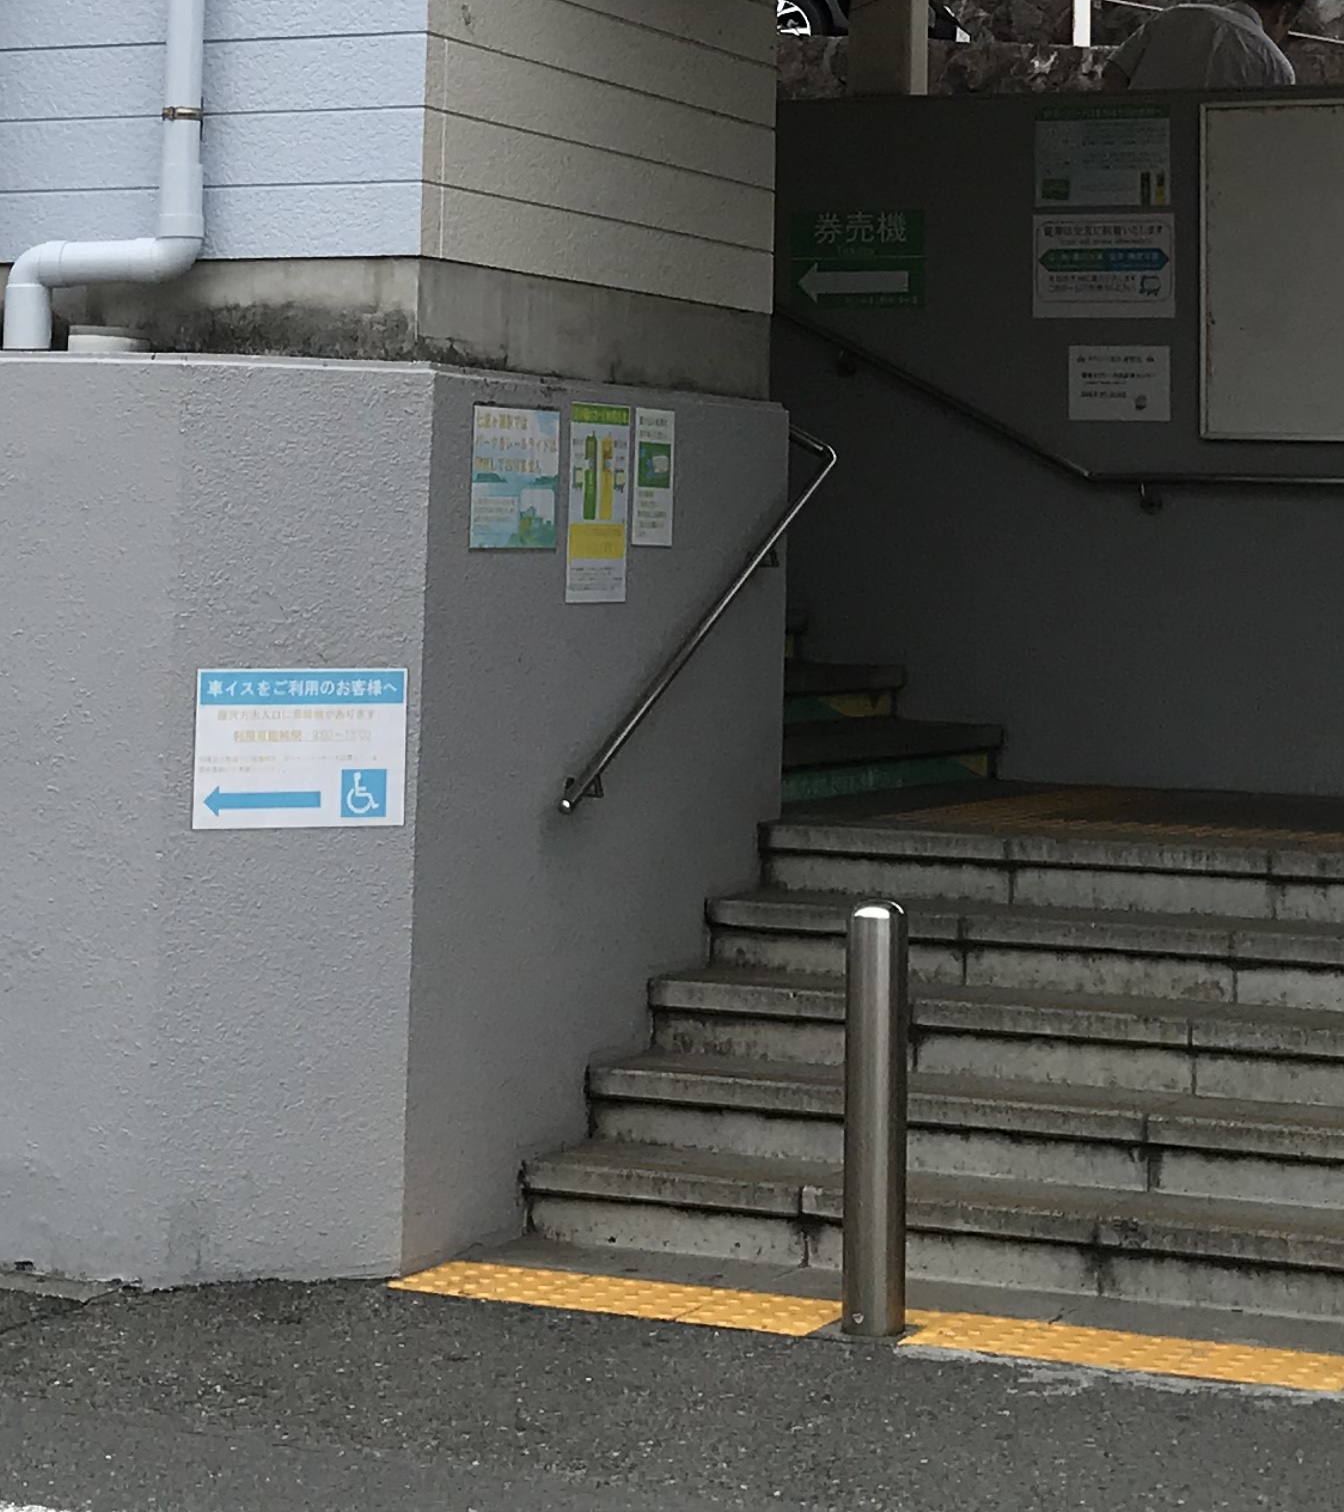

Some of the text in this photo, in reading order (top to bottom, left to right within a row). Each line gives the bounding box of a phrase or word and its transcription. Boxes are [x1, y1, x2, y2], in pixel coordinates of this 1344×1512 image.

[813, 211, 907, 244] 券売機
[207, 678, 398, 698] 車イスをご利用のお客様へ
